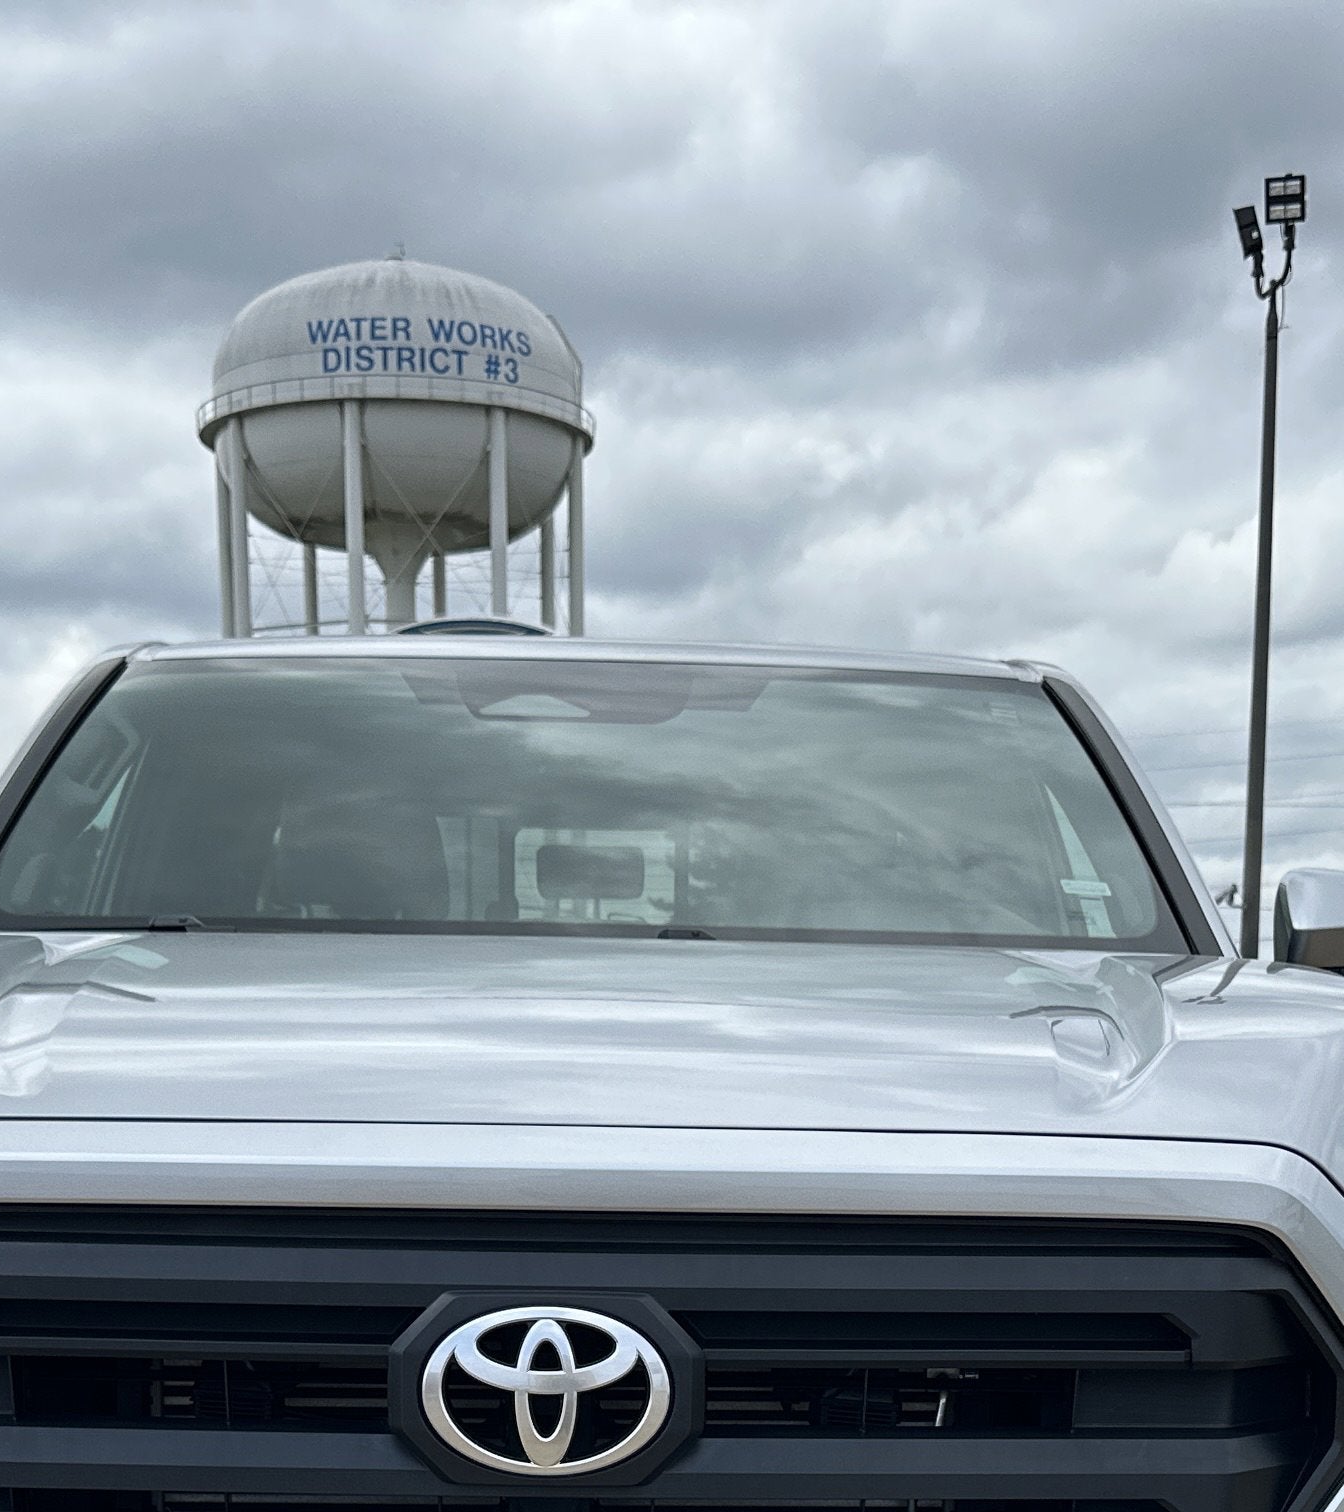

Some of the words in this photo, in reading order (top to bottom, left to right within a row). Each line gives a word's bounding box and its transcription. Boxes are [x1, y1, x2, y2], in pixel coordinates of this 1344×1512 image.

[307, 317, 412, 345] WATER
[427, 318, 532, 357] WORKS
[322, 346, 469, 375] DISTRICT
[485, 354, 520, 384] #3
